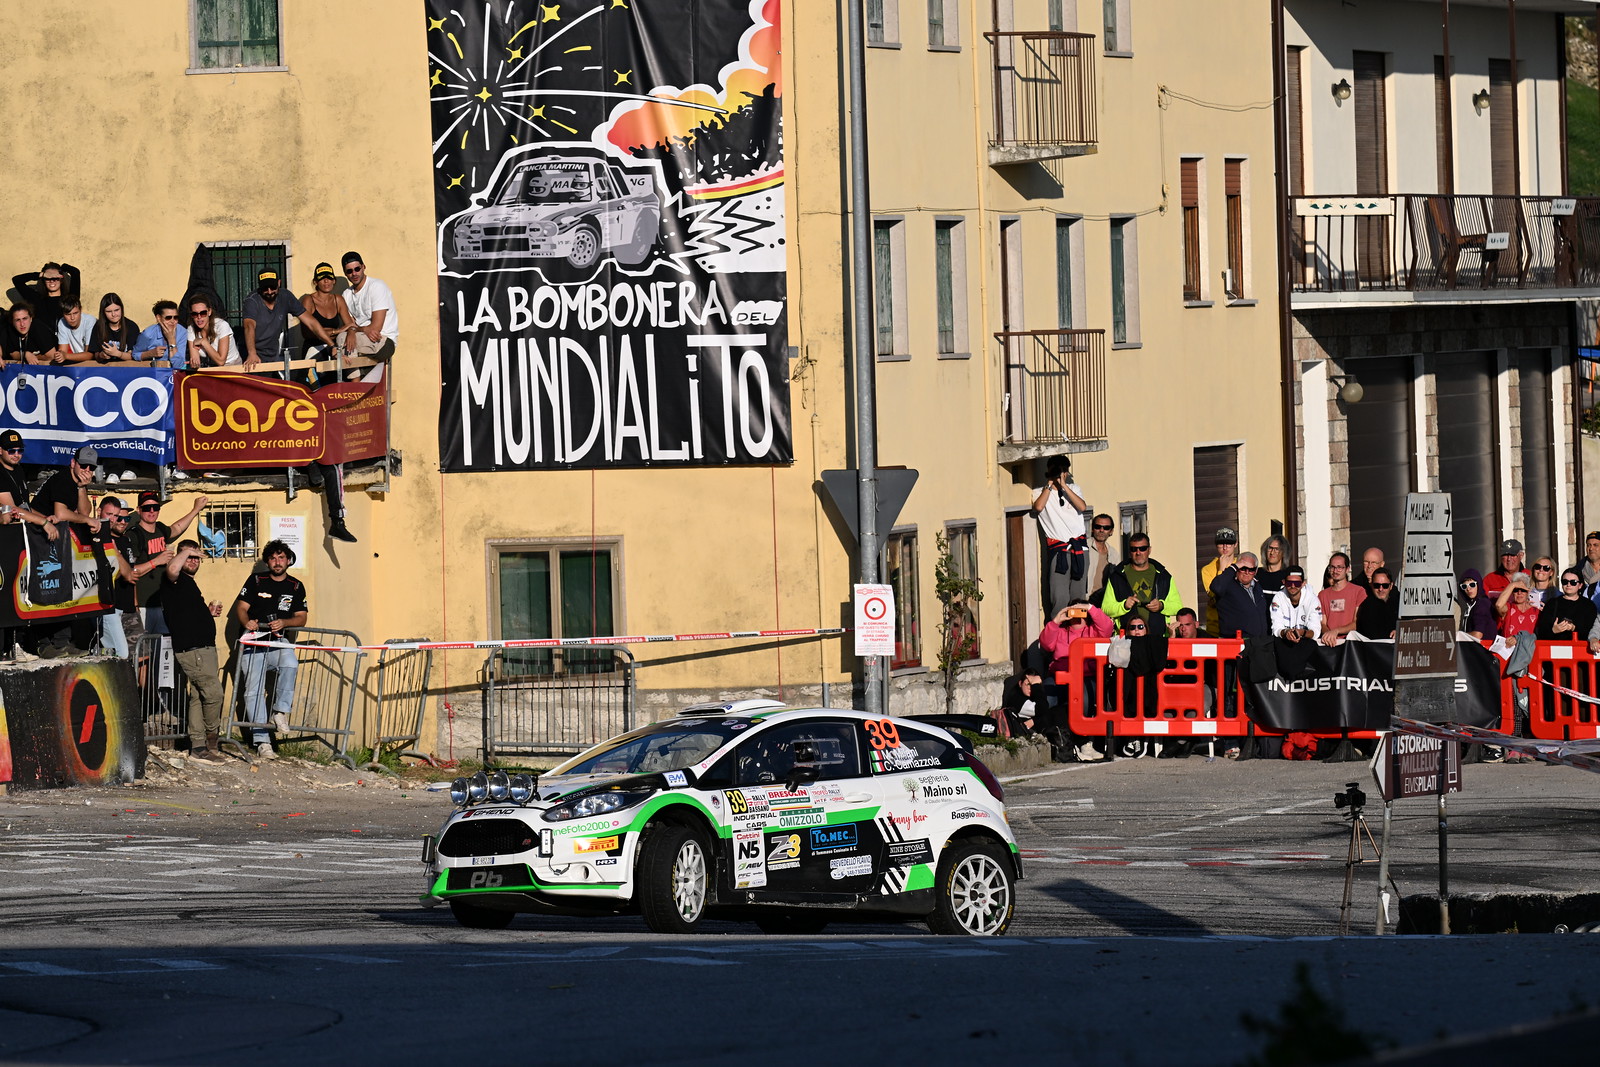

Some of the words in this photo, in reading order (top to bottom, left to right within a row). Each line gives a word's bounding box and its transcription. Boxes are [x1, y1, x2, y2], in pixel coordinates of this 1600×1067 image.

[519, 164, 548, 173] LANCIA
[548, 163, 586, 171] MARTINI
[457, 287, 502, 332] LA
[508, 280, 728, 332] BOMBONERA
[736, 312, 775, 322] DEL
[0, 374, 168, 428] arco
[190, 388, 318, 434] base
[52, 440, 164, 456] www.srco-official.com
[192, 438, 246, 450] bassano
[254, 436, 319, 449] serramenti
[1410, 502, 1434, 521] MALAGHI
[1406, 545, 1426, 563] SALINE
[1404, 588, 1420, 605] CIMA
[1421, 587, 1442, 604] CAINA
[1399, 627, 1421, 644] Madonna
[1397, 650, 1414, 668] Monte
[1416, 650, 1430, 667] Caina
[1268, 676, 1394, 692] INDUSTRIAL
[864, 718, 900, 750] 39
[1392, 735, 1442, 755] RISTORANTE
[1401, 752, 1440, 774] MILLELUC
[918, 774, 950, 784] segheria
[923, 785, 953, 797] Maino
[956, 783, 968, 794] srl
[726, 790, 747, 813] 39
[749, 805, 769, 813] BASSANO
[734, 813, 777, 821] INDUSTRIAL
[780, 814, 822, 827] OMIZZOLO
[913, 810, 928, 823] bar
[951, 811, 975, 820] Baggio
[552, 821, 610, 836] ineFoto2000
[738, 841, 760, 860] N5
[767, 834, 801, 860] Z3
[904, 843, 926, 852] STORE
[470, 871, 503, 888] Pb
